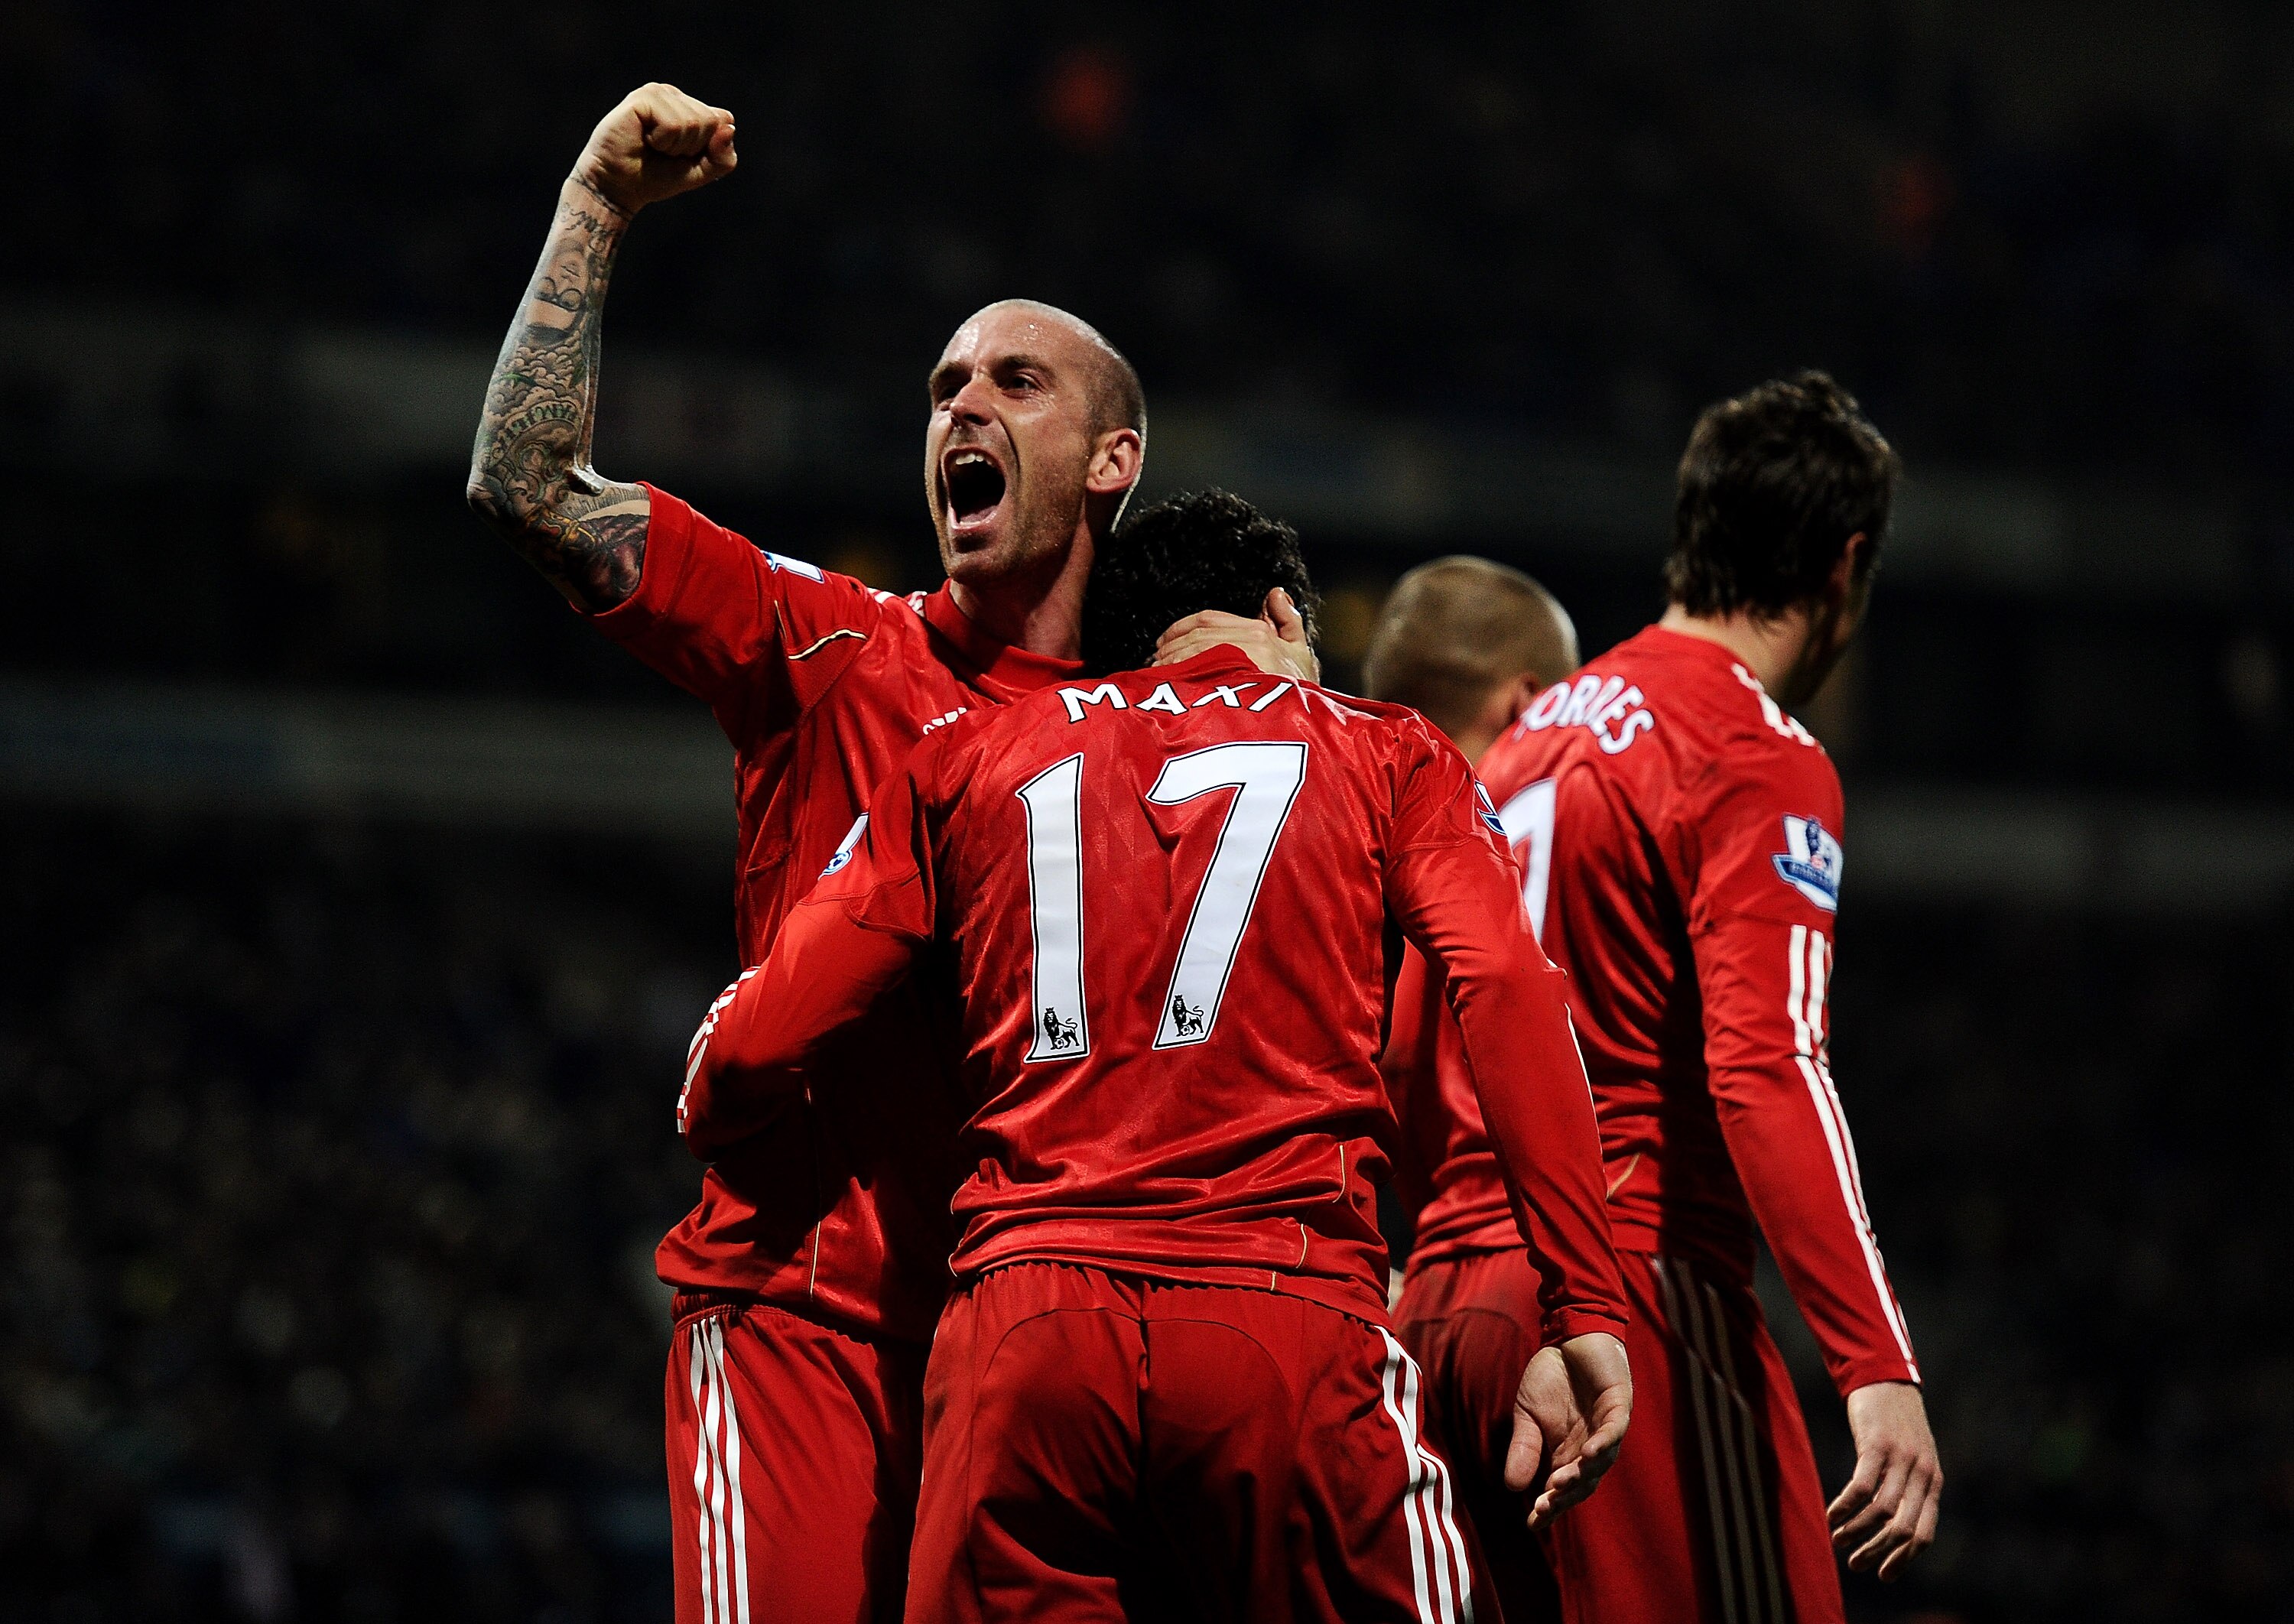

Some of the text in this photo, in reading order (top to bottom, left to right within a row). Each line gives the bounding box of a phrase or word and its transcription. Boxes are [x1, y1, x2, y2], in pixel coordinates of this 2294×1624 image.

[1058, 681, 1293, 723] MAXI
[1513, 674, 1655, 755] ORES
[1015, 741, 1308, 1062] 17
